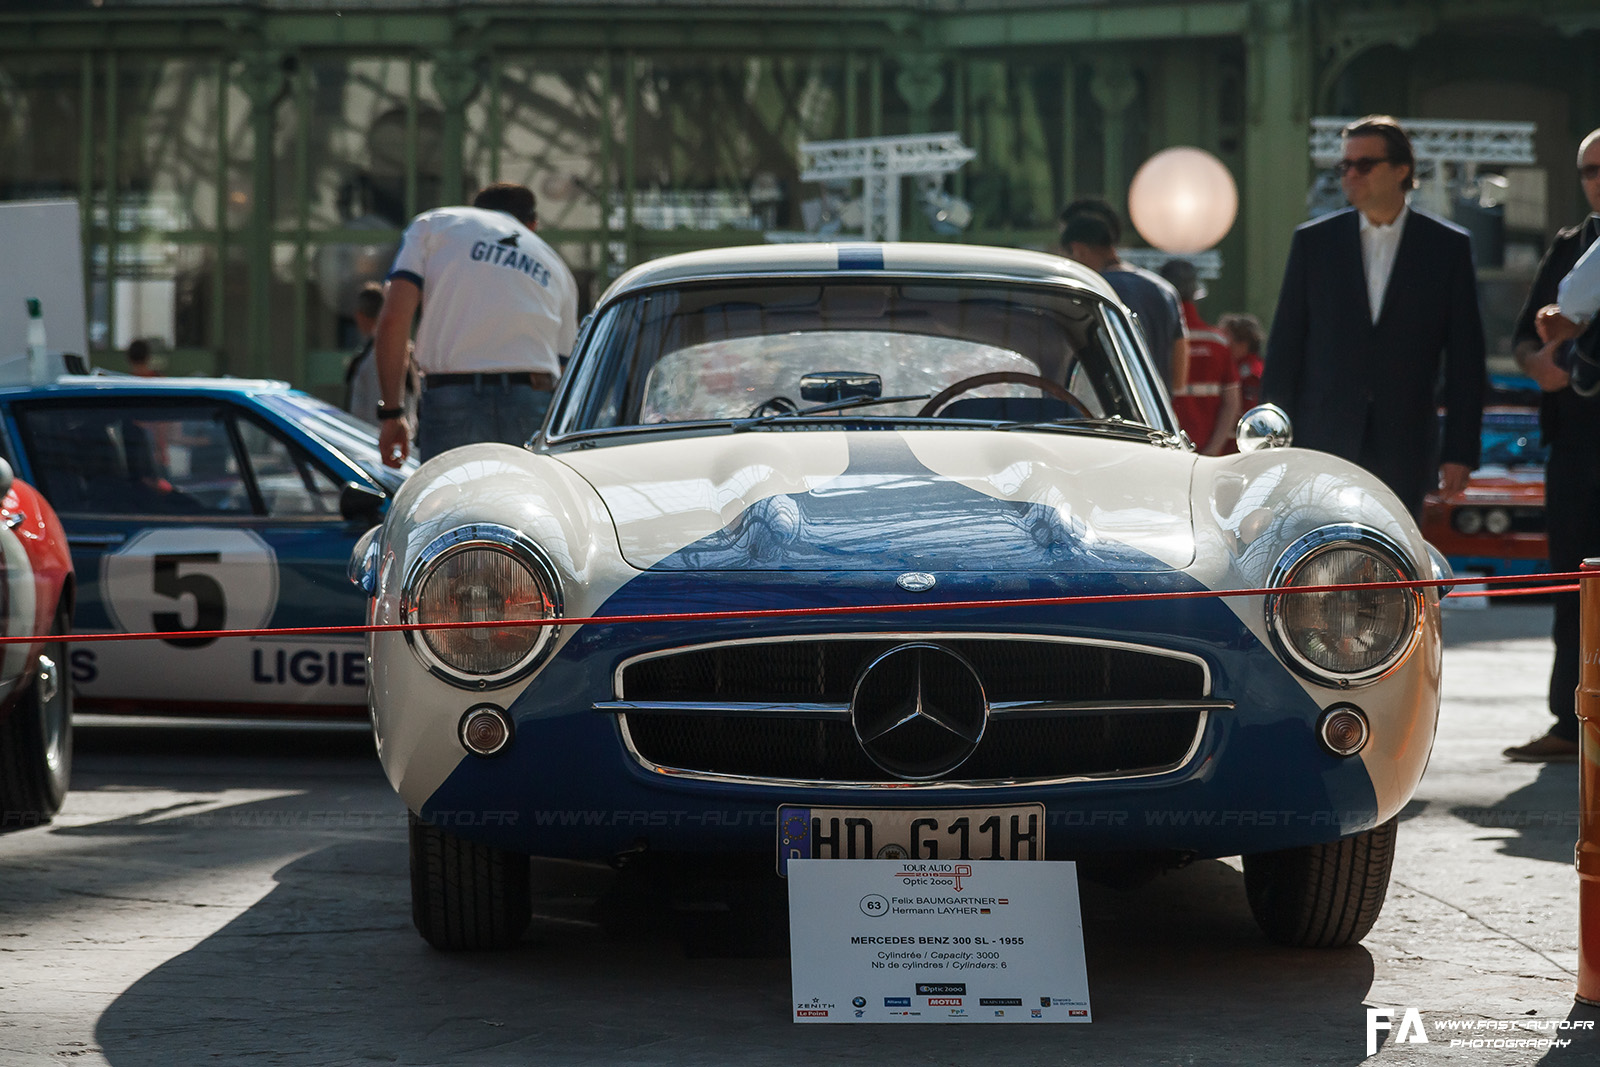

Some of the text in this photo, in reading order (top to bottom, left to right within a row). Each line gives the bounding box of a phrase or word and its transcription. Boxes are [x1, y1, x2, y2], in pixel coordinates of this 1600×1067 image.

[470, 240, 552, 288] GITANES
[152, 552, 227, 648] 5
[812, 813, 1038, 861] HD G11H
[903, 864, 952, 872] TOUR AUTO
[902, 877, 928, 887] Optic
[891, 896, 997, 905] Felix BAUMGARTNER
[866, 901, 882, 910] 63
[892, 906, 935, 914] Hermann
[850, 936, 916, 945] MERCEDES
[918, 936, 950, 945] BENZ
[952, 936, 972, 945] 300
[974, 936, 989, 945] SL
[999, 936, 1025, 945] 1955
[877, 951, 922, 961] Cylindrée
[930, 951, 974, 961] Capacity:
[976, 951, 1000, 959] 3000
[871, 961, 886, 969] Nb
[887, 961, 900, 969] de
[902, 961, 944, 970] cylindres
[952, 961, 999, 970] Cylinders:
[1001, 961, 1008, 969] 6
